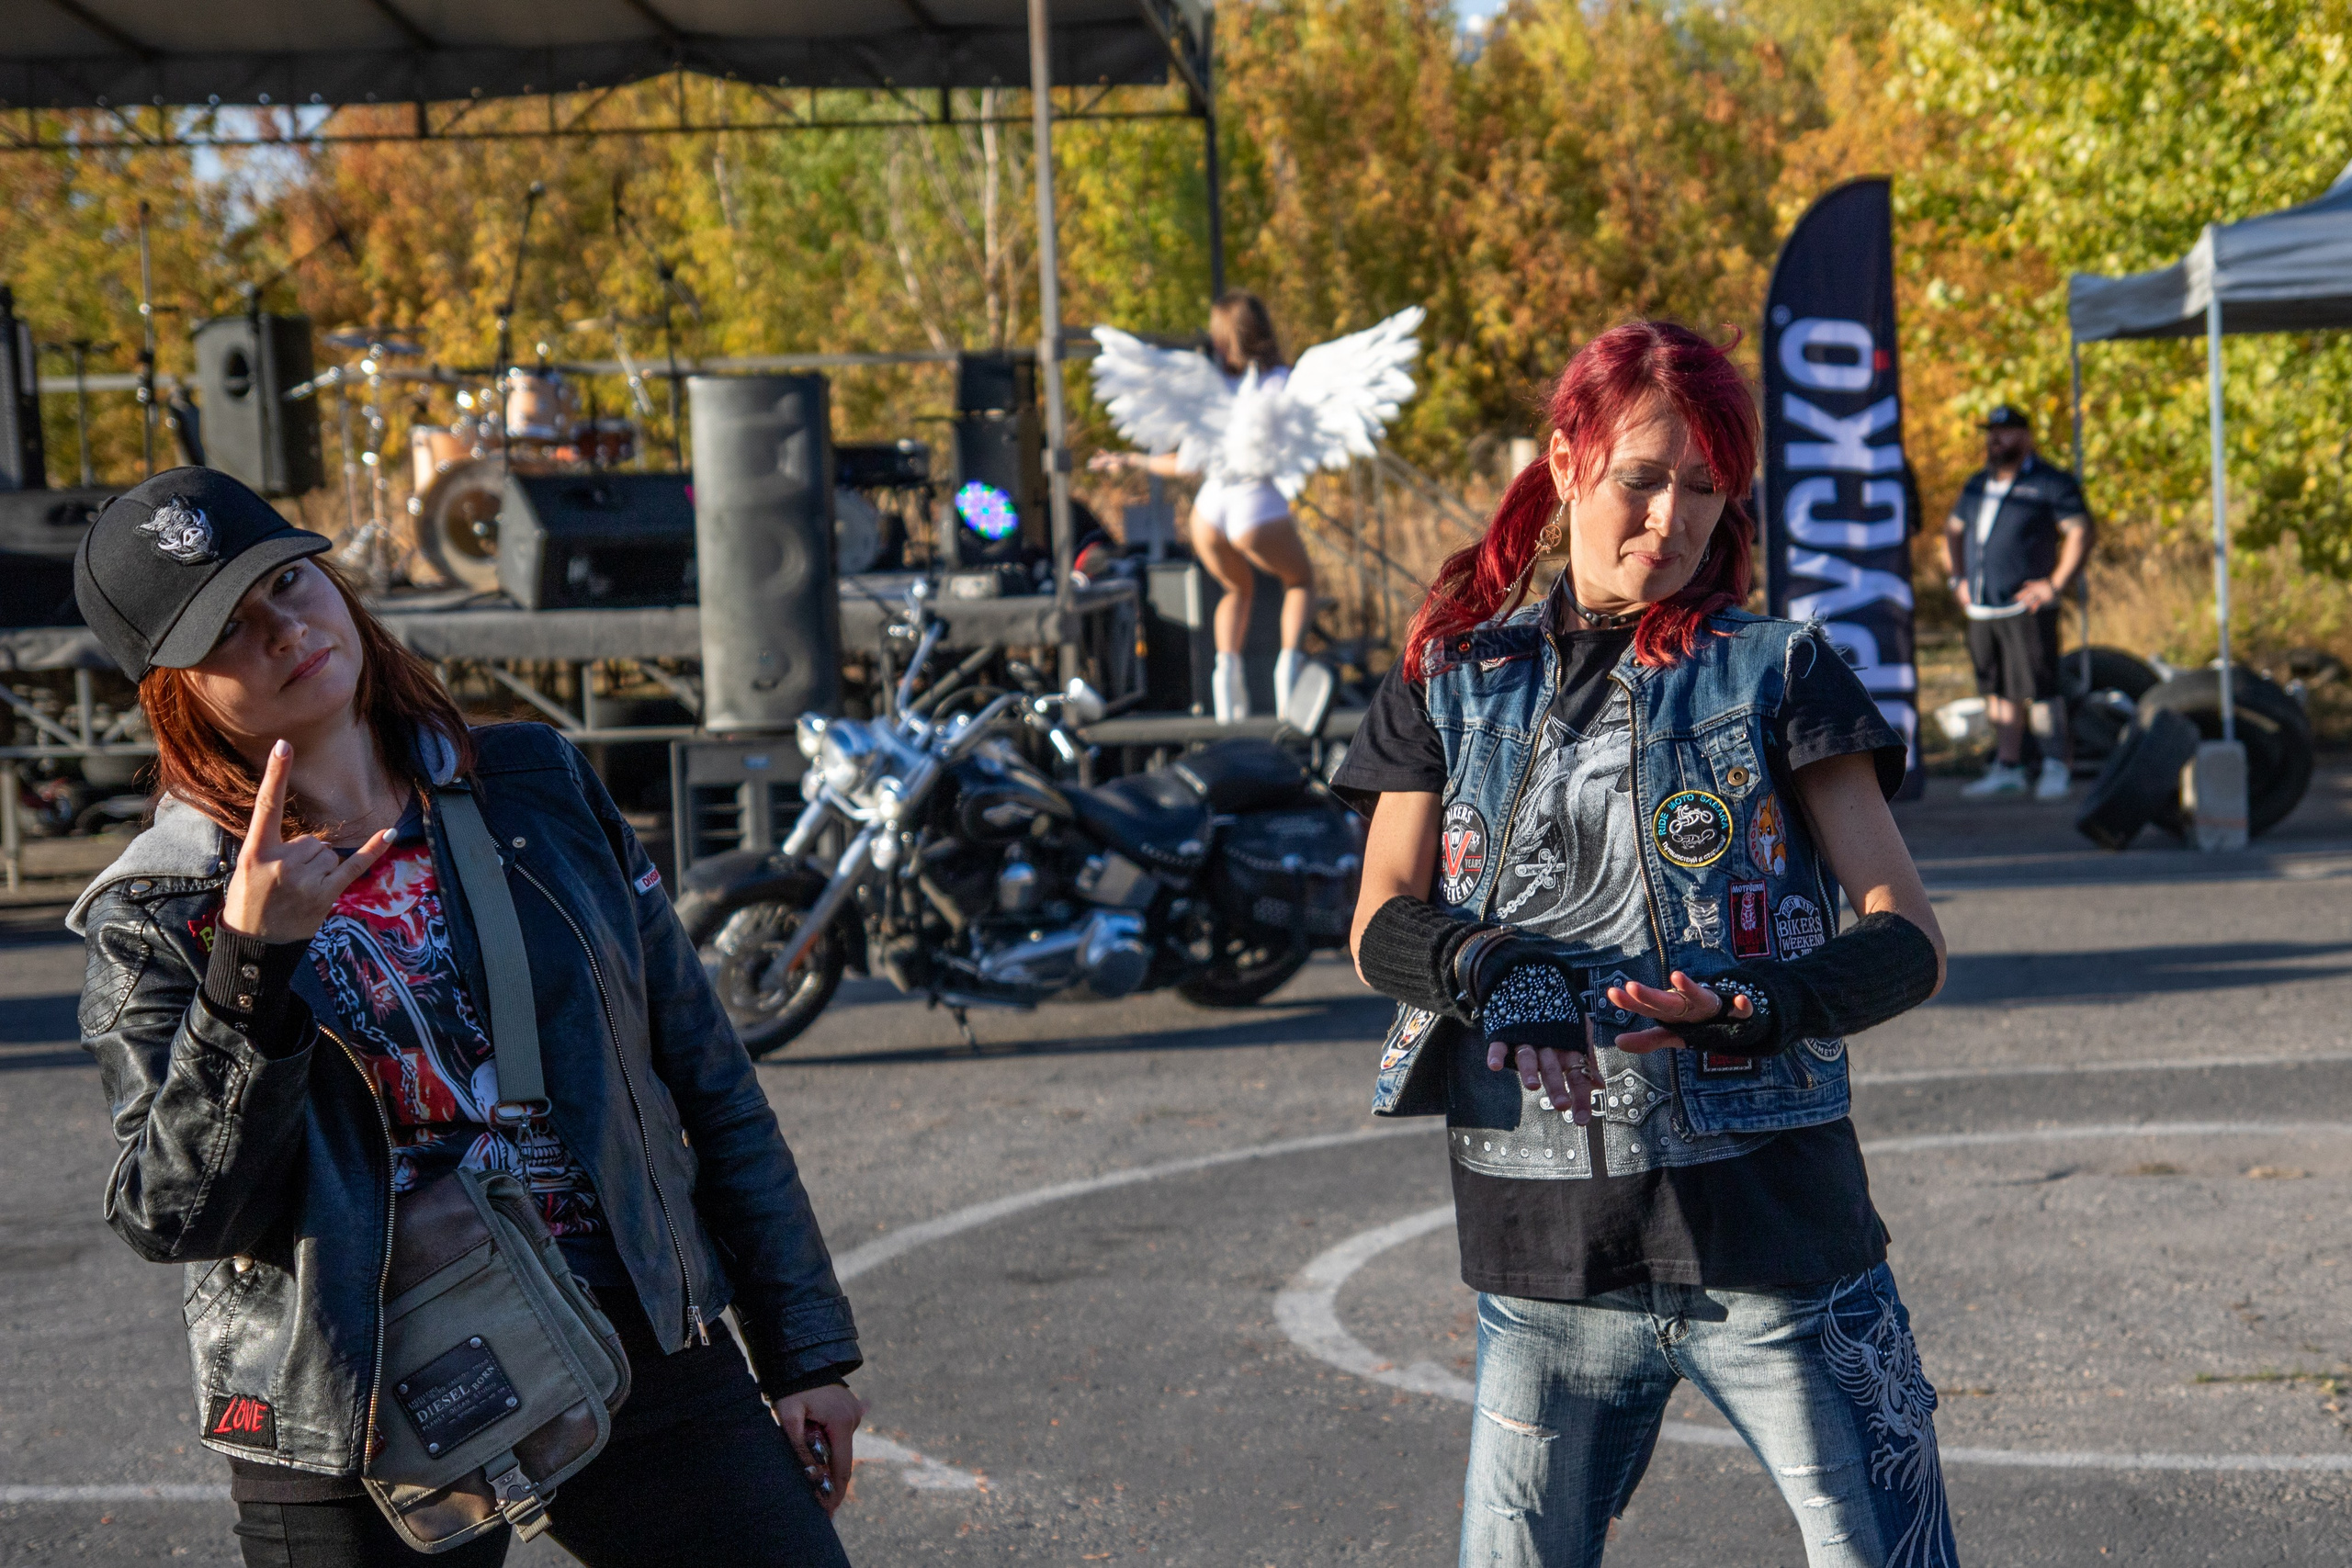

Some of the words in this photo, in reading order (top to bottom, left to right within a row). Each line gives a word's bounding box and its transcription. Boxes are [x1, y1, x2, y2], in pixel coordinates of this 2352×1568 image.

[1447, 806, 1473, 824] BIKERS
[1657, 812, 1668, 836] RIDE
[1668, 794, 1694, 810] MOTO
[1700, 795, 1728, 829] SAMARA
[1464, 858, 1481, 869] YEARS
[1439, 876, 1474, 901] WEEKEND
[1779, 917, 1823, 937] BIKERS
[1782, 934, 1825, 951] WEEKEND
[416, 1384, 470, 1423] DIESEL
[471, 1365, 494, 1390] BORN
[423, 1414, 446, 1431] PLANET
[449, 1399, 470, 1414] OCEAN
[473, 1382, 496, 1398] STUDIO
[213, 1396, 266, 1433] LOVE
